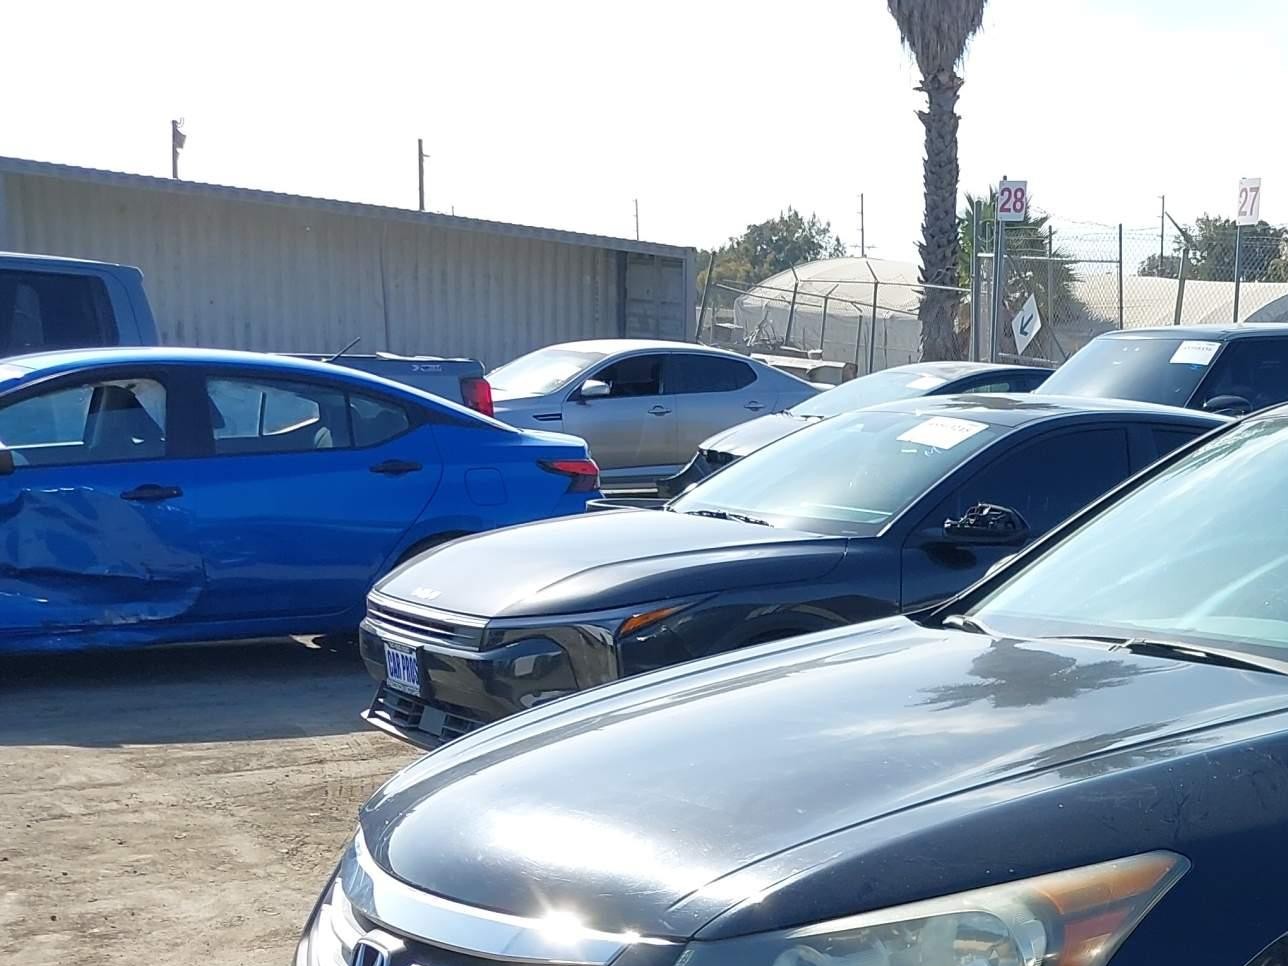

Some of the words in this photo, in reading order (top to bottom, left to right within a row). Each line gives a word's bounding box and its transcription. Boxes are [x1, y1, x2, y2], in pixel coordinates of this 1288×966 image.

[999, 187, 1025, 213] 28
[1239, 186, 1260, 216] 27
[387, 647, 402, 681] CAR
